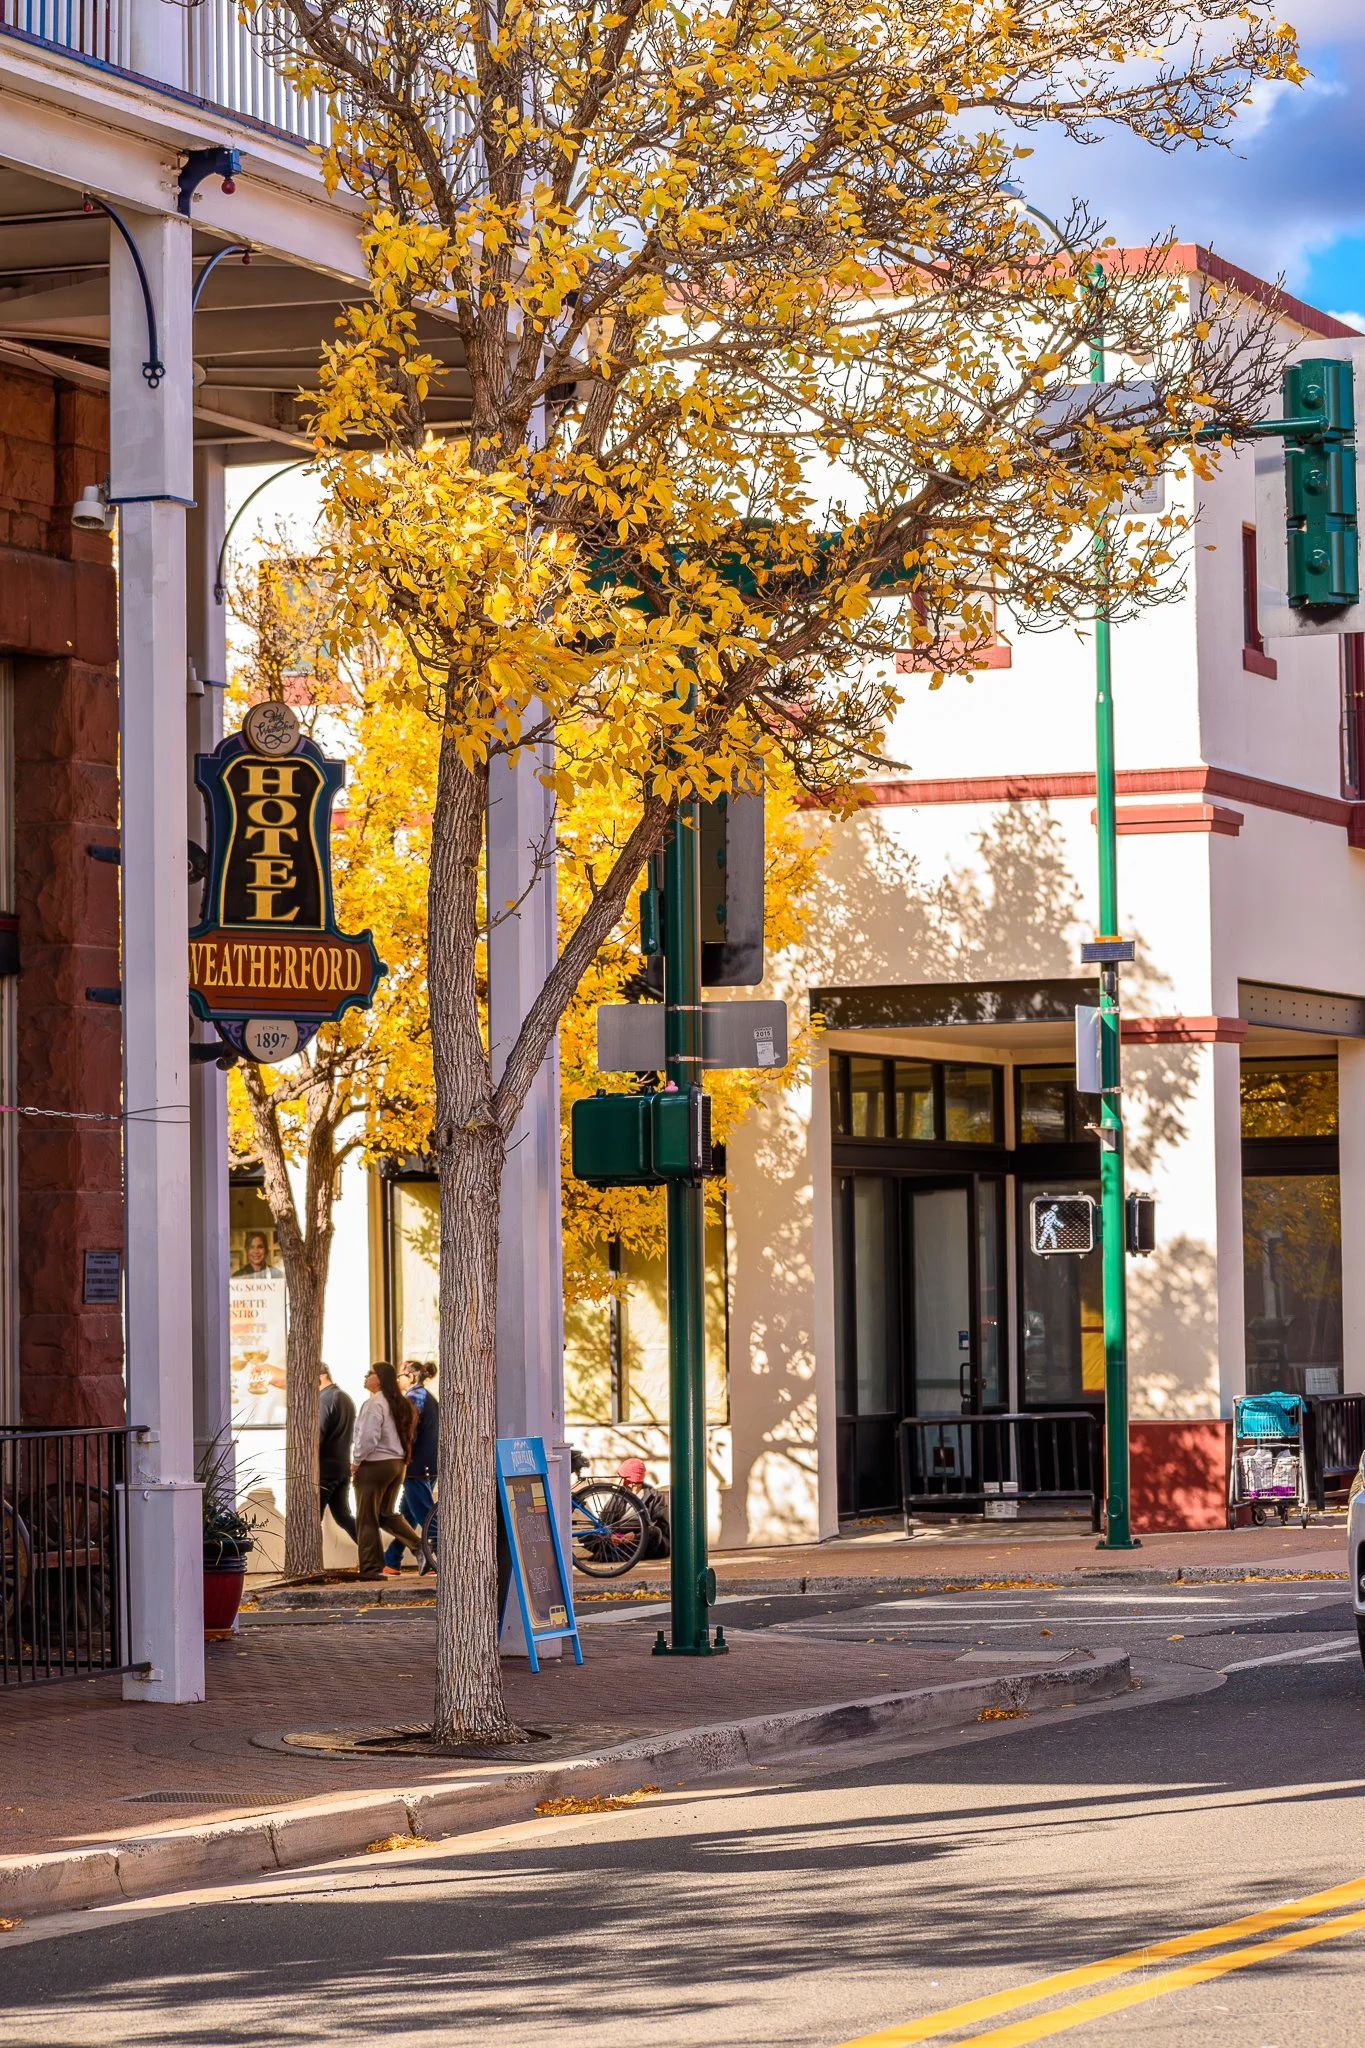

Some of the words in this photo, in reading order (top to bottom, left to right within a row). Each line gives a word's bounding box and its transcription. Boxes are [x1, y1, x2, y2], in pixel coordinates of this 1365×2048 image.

[241, 765, 301, 921] HOTEL
[188, 943, 362, 992] WEATHERFORD
[256, 1032, 288, 1049] 1897
[245, 1283, 276, 1292] SOON!
